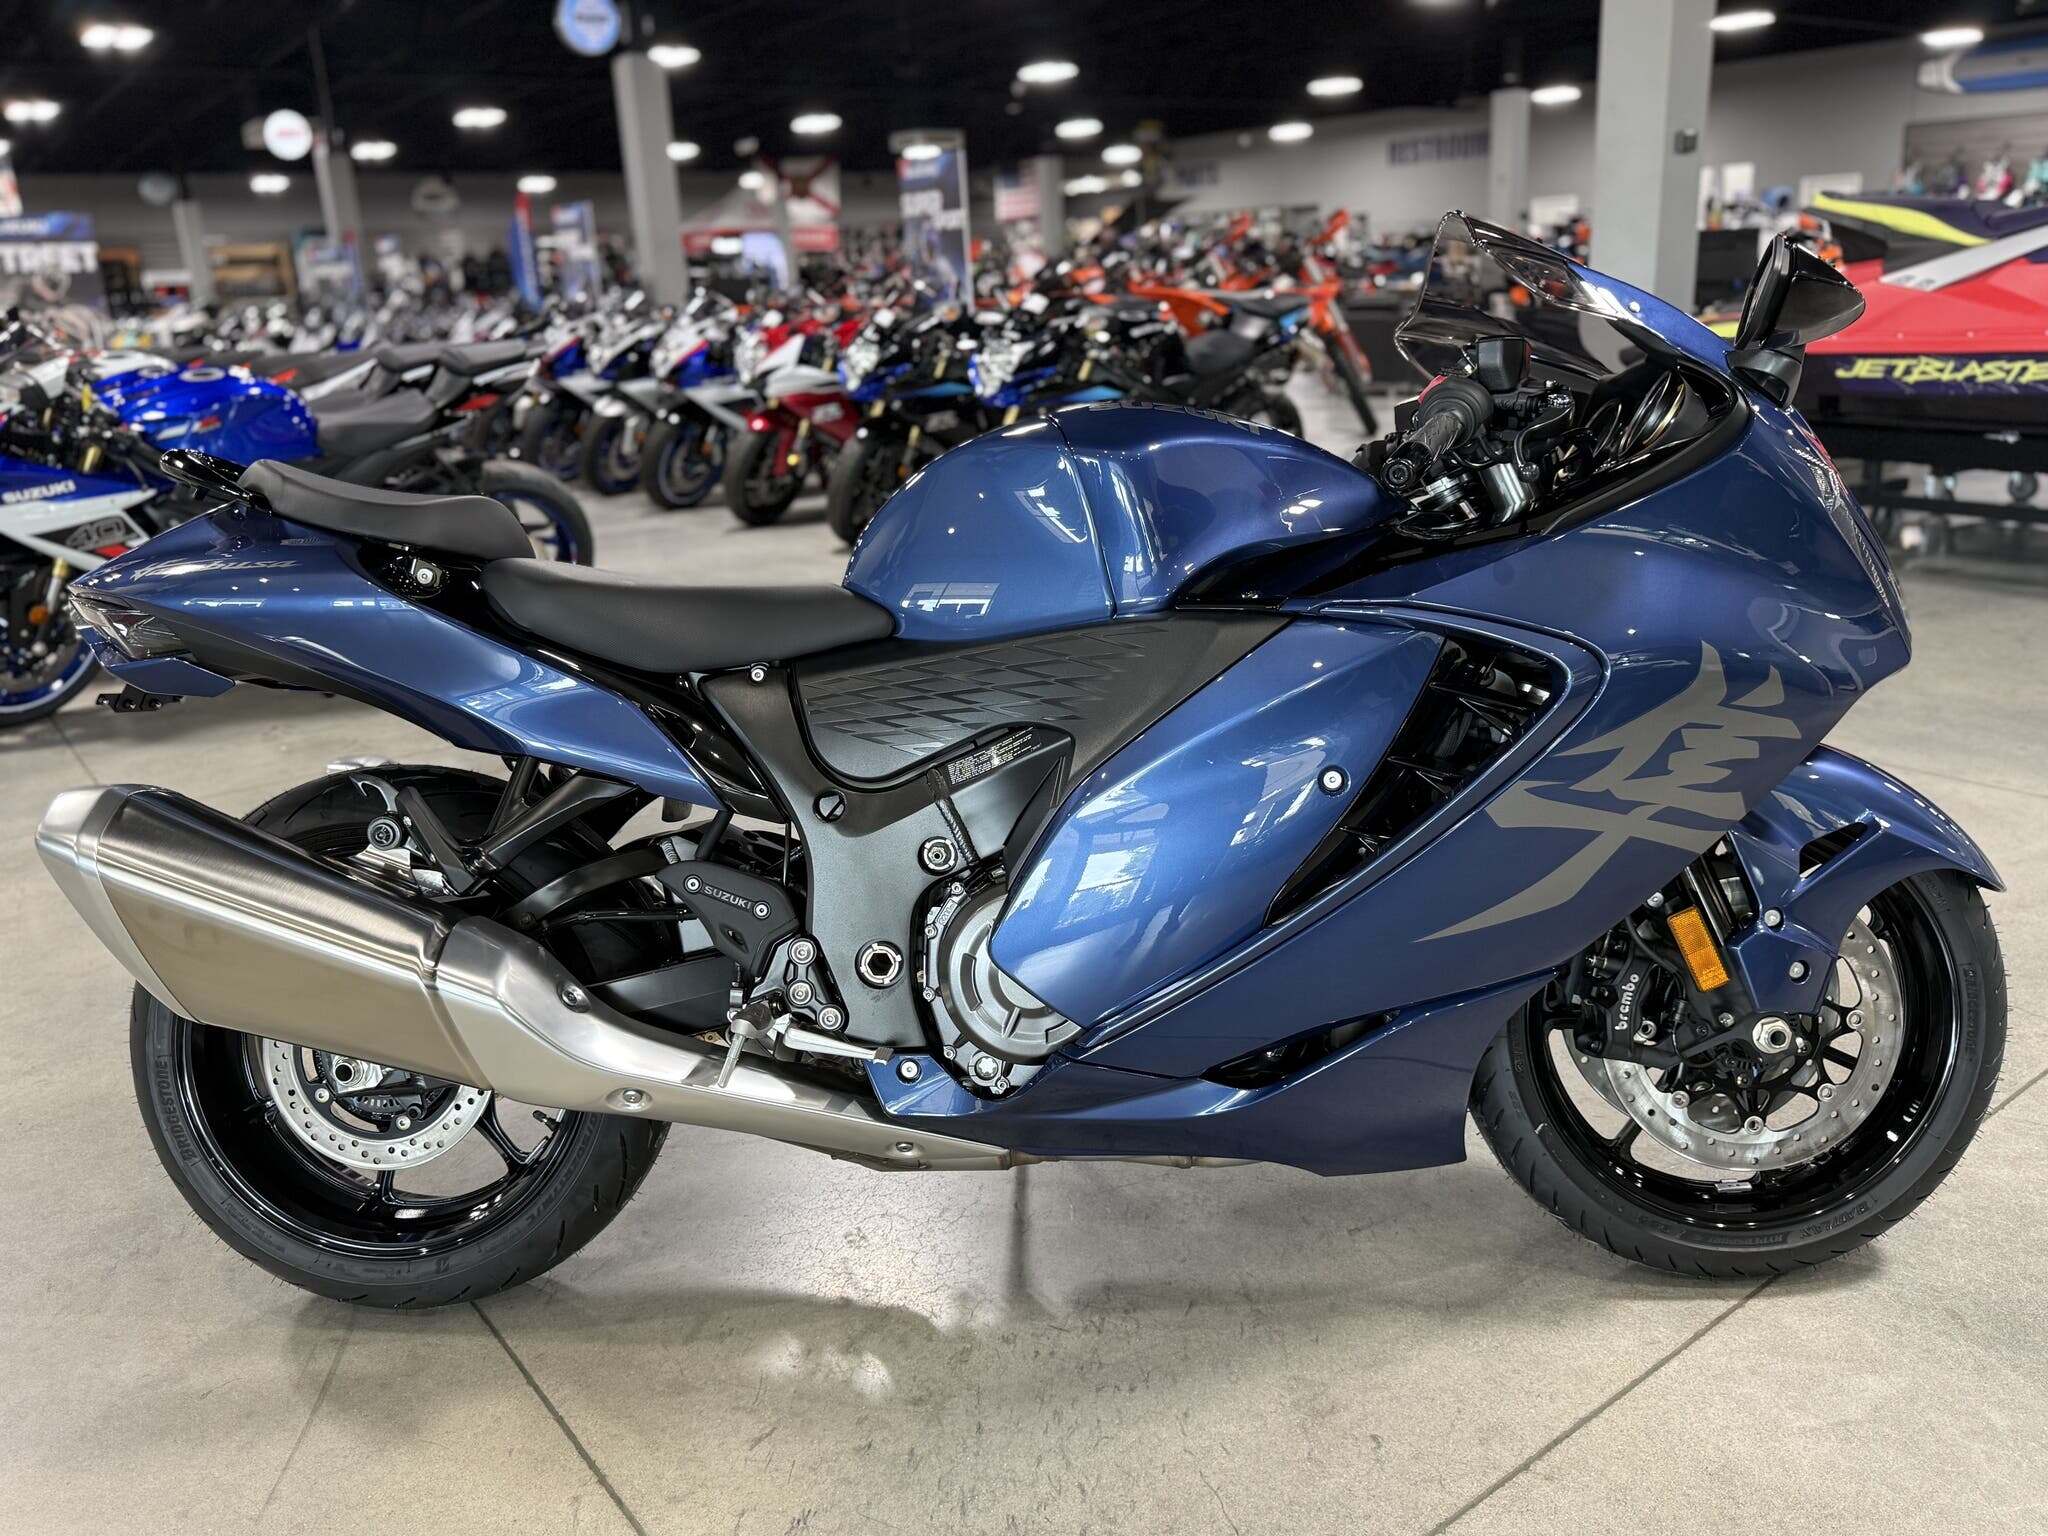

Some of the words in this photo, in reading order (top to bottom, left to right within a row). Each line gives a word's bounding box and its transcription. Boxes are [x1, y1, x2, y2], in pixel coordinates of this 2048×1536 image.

[1, 479, 77, 504] SUZUKI
[703, 885, 753, 910] SUZUKI
[1614, 973, 1639, 1031] brembo
